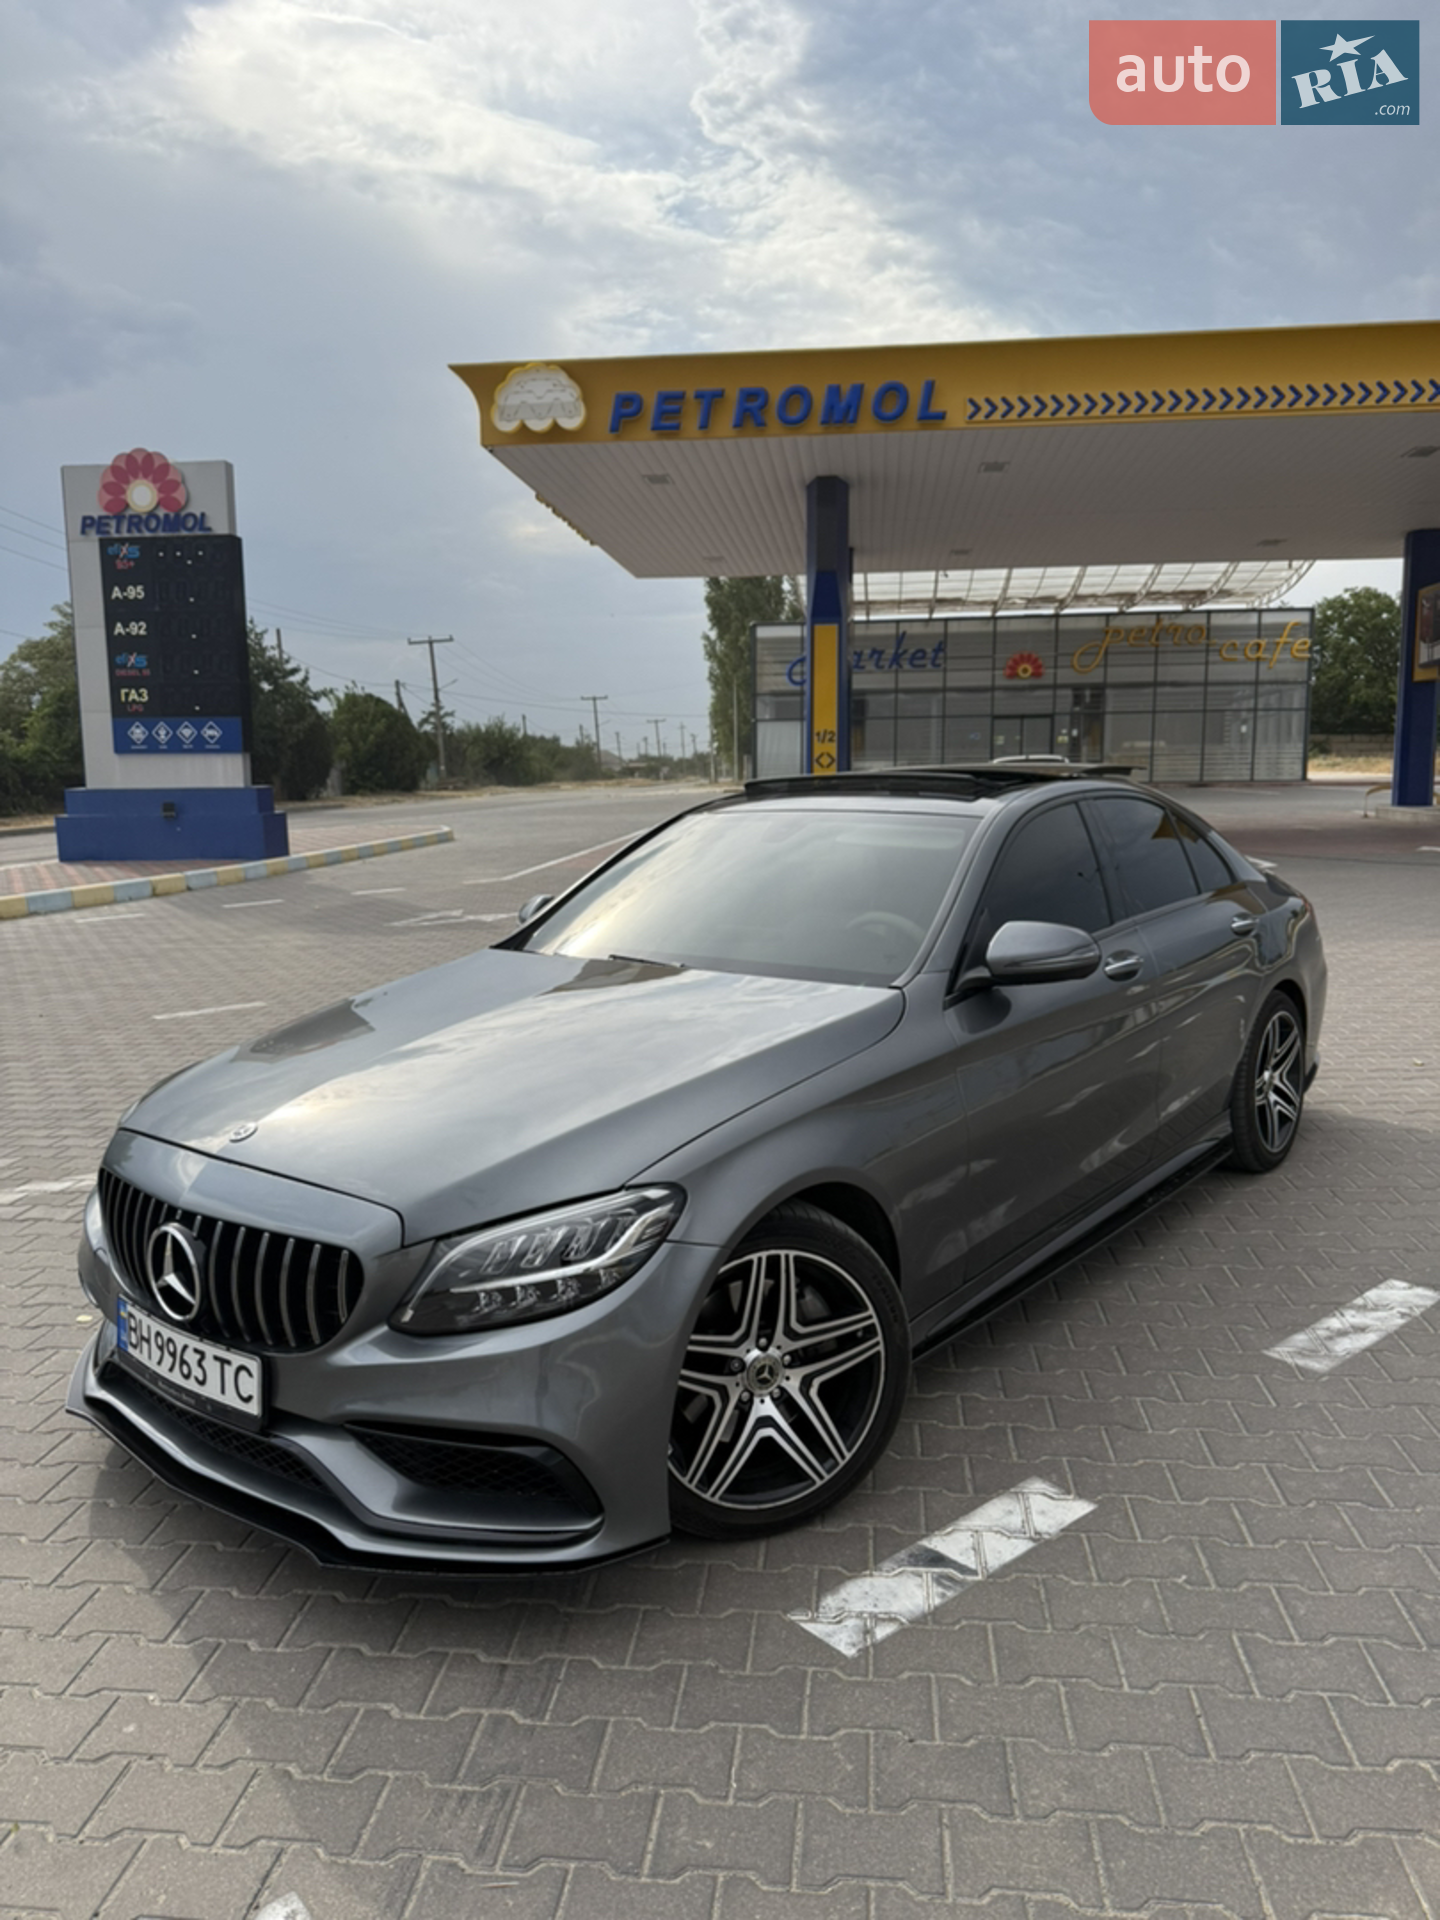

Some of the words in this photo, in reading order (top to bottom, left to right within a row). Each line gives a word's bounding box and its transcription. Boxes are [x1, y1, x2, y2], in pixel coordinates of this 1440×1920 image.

[608, 379, 947, 434] PETROMOL
[80, 512, 213, 536] PETROMOL
[1071, 617, 1214, 674] petro
[1220, 619, 1312, 670] cafe
[120, 688, 149, 703] ГАЗ
[815, 729, 836, 744] 1/2
[154, 1330, 208, 1387] 9963
[213, 1354, 255, 1405] TC
